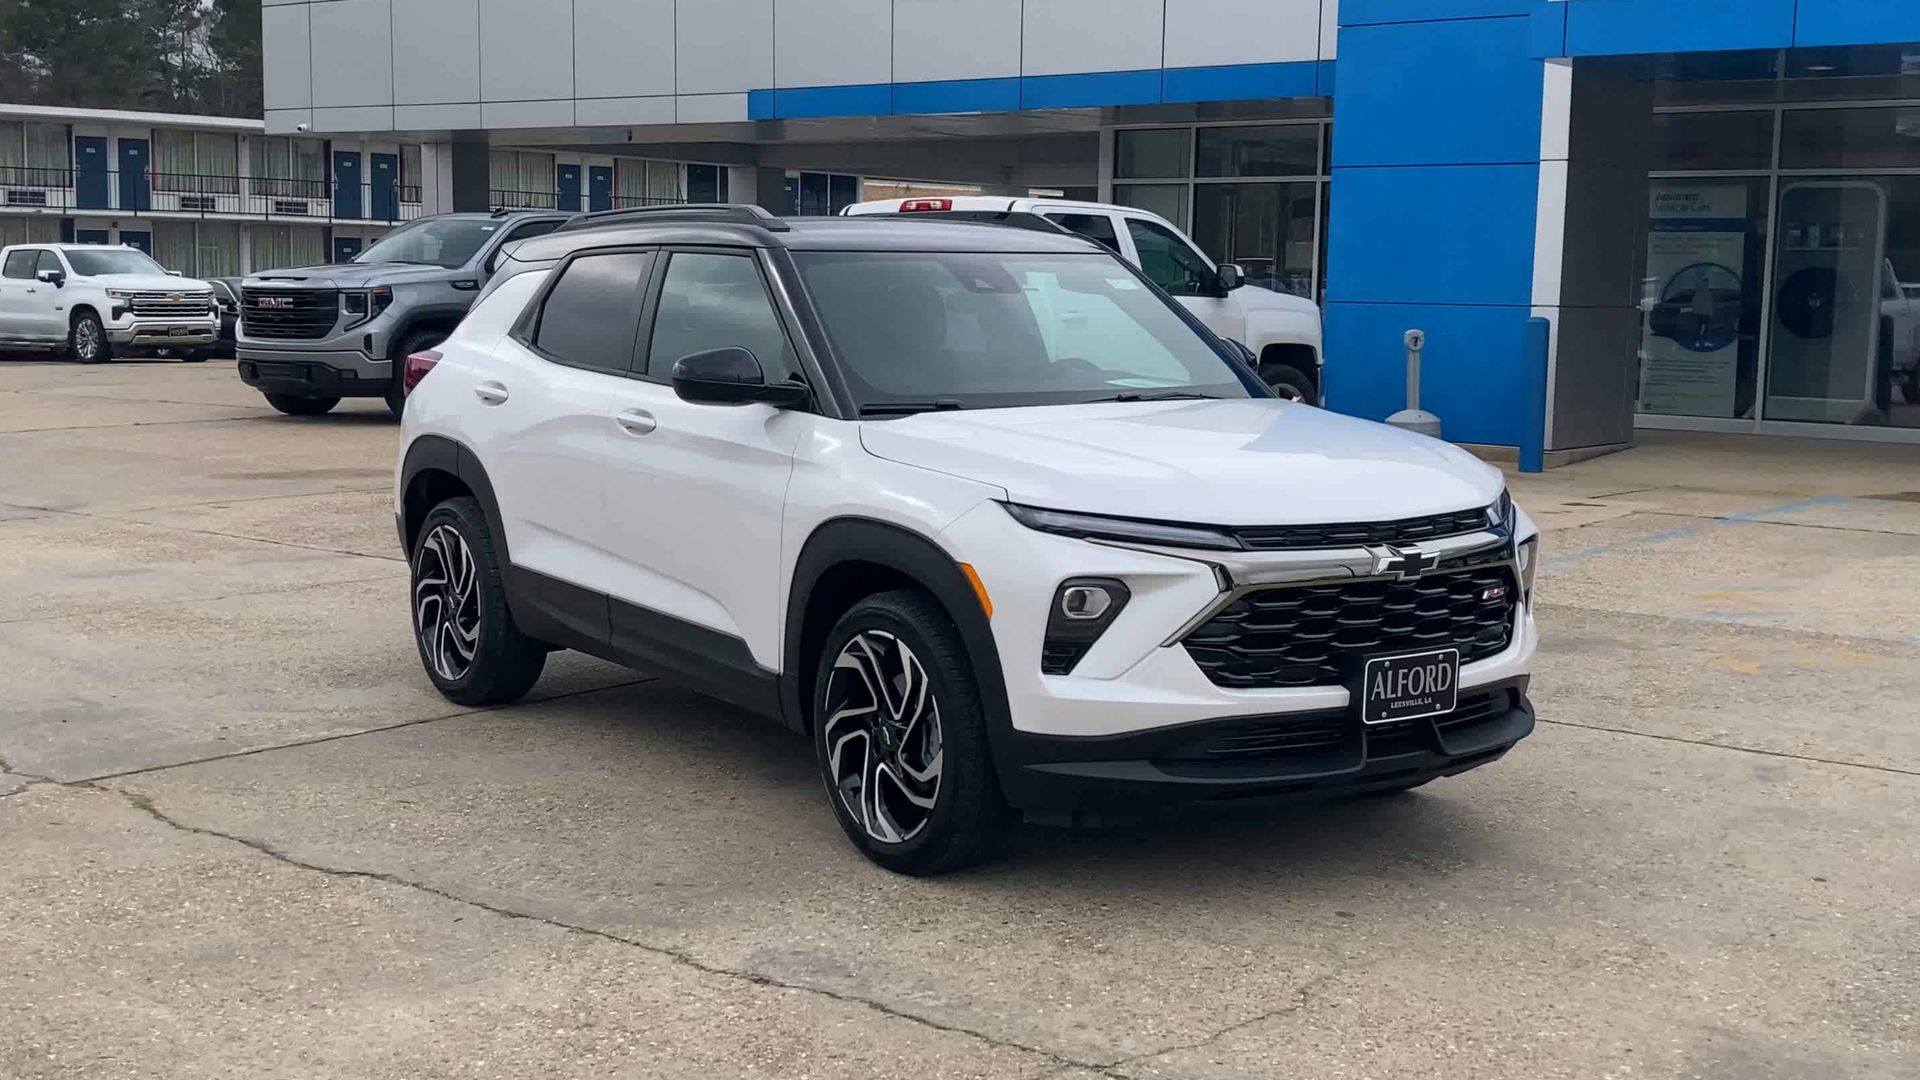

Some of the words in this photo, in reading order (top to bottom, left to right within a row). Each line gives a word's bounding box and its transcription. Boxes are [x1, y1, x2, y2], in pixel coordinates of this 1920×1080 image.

[257, 297, 294, 309] GMC
[1371, 663, 1452, 701] ALFORD
[1390, 698, 1424, 709] LEESVILLE,
